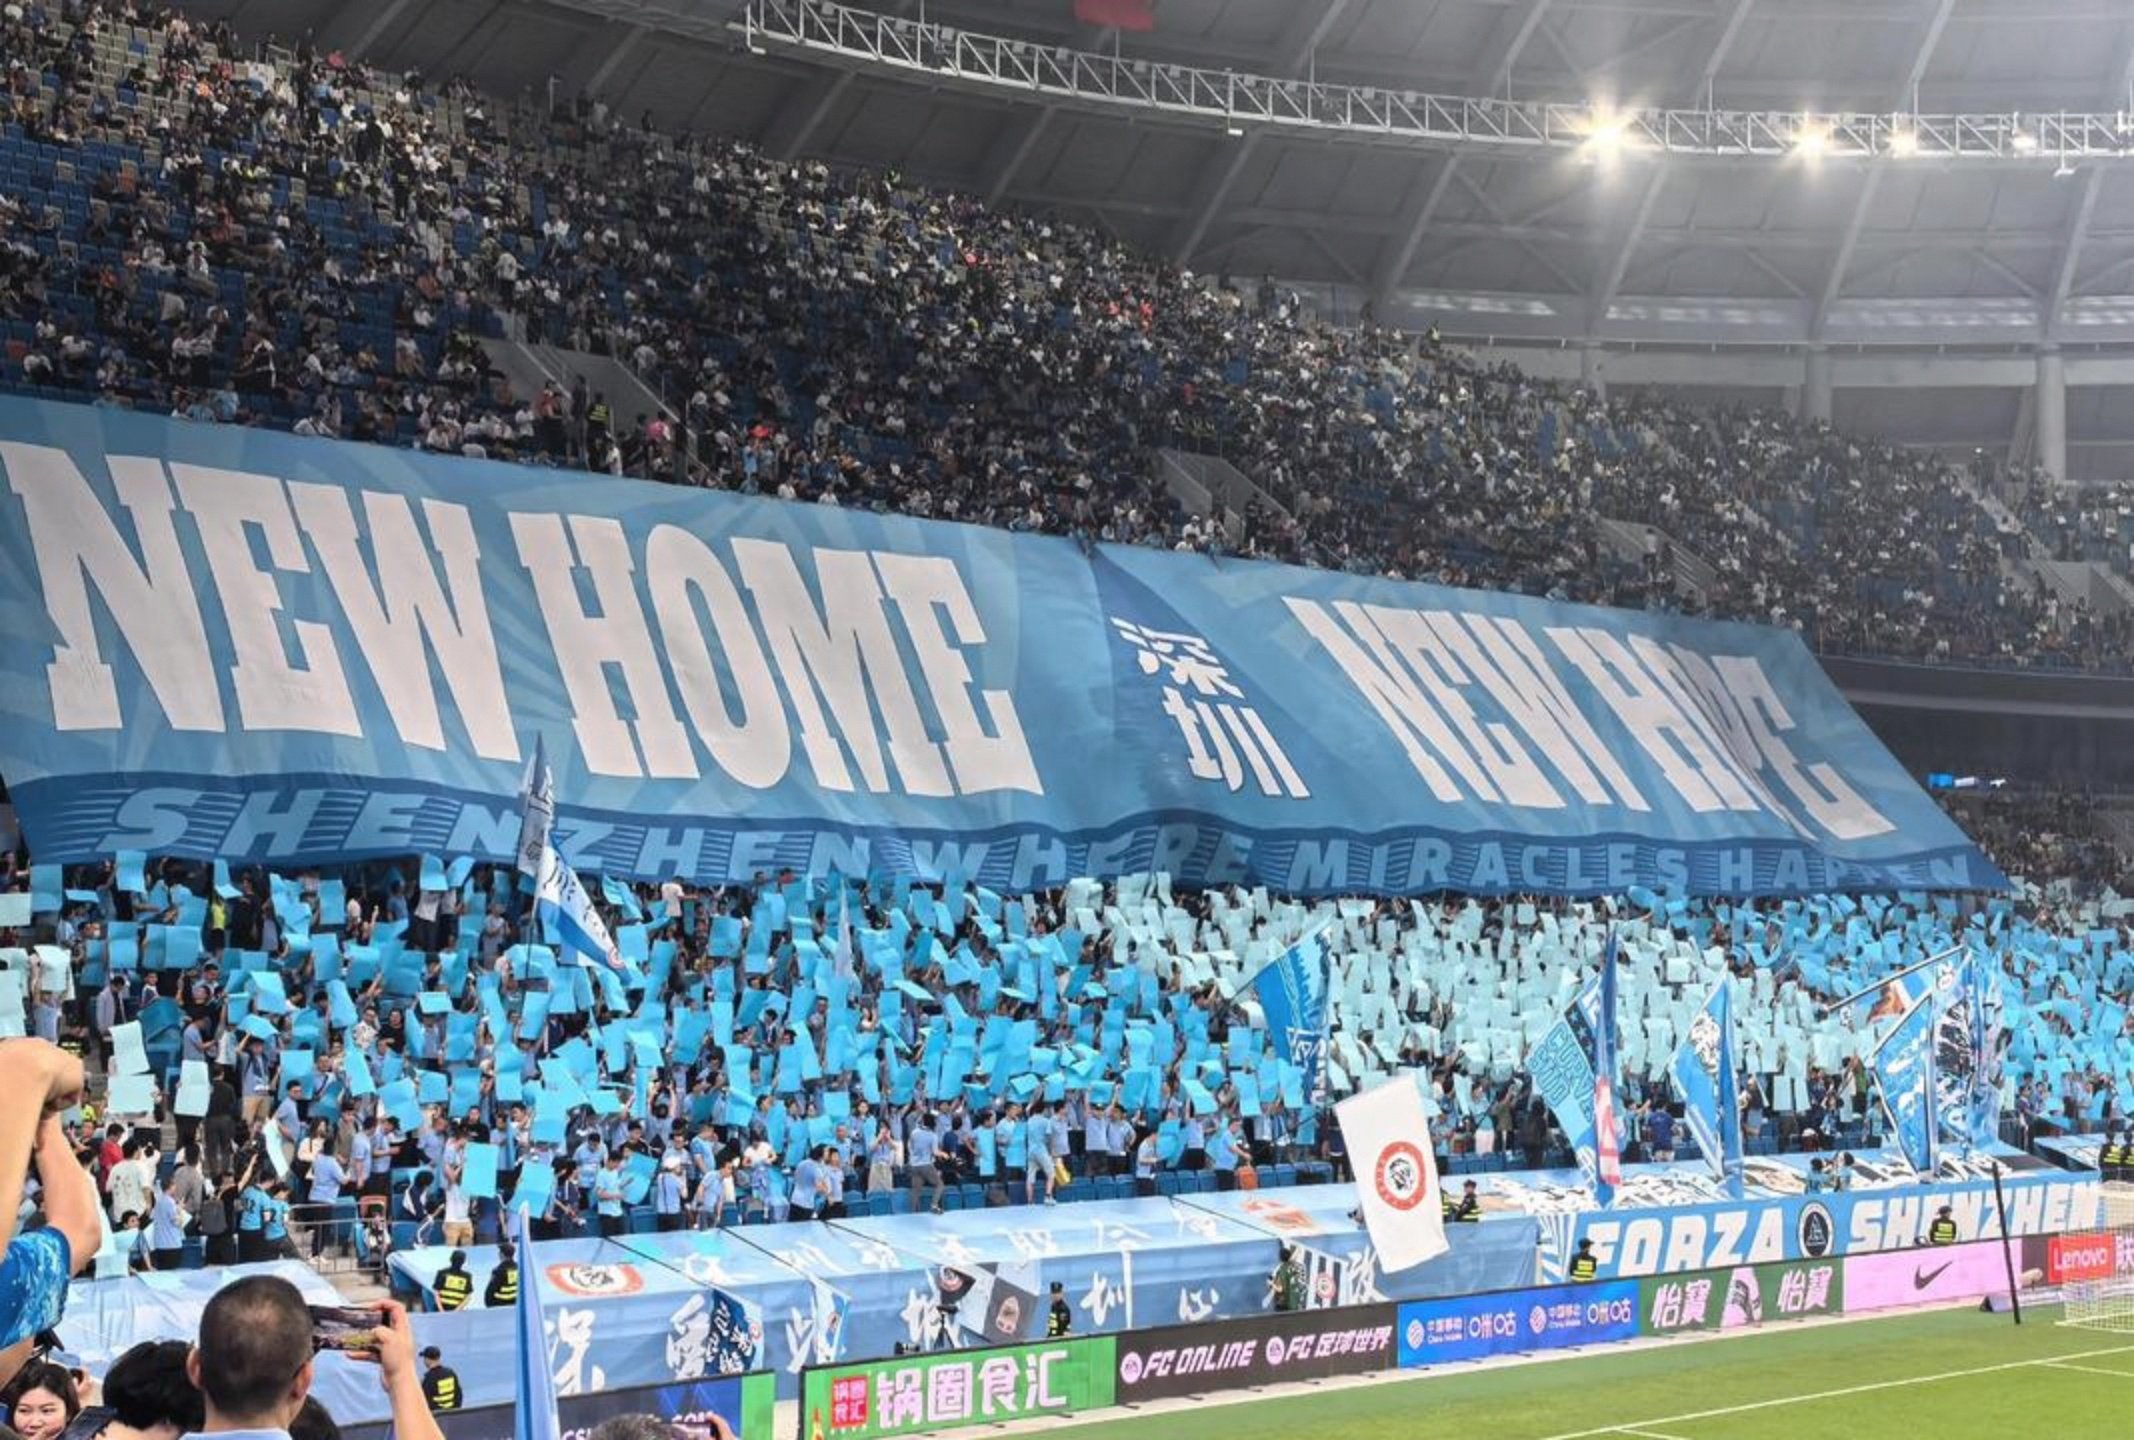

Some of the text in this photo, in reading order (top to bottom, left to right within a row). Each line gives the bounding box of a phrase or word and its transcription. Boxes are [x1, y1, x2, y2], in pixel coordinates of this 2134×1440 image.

[1, 441, 1044, 798] NEW HOME
[1110, 617, 1311, 799] 深圳
[1280, 596, 1898, 841] NEW HPE
[95, 788, 871, 880] SHENZHEN
[911, 822, 1254, 889] WHERE
[1286, 837, 1689, 890] MIRACLES
[1585, 1179, 2103, 1278] FORZA SHENZHEN
[2053, 1247, 2109, 1271] Lenovo
[1651, 1279, 1712, 1329] 怡寶
[1777, 1266, 1833, 1313] 怡寶
[1141, 1349, 1177, 1379] FC
[1175, 1339, 1259, 1376] ONLINE
[1285, 1334, 1316, 1361] FC
[876, 1350, 1068, 1430] 锅圈食汇
